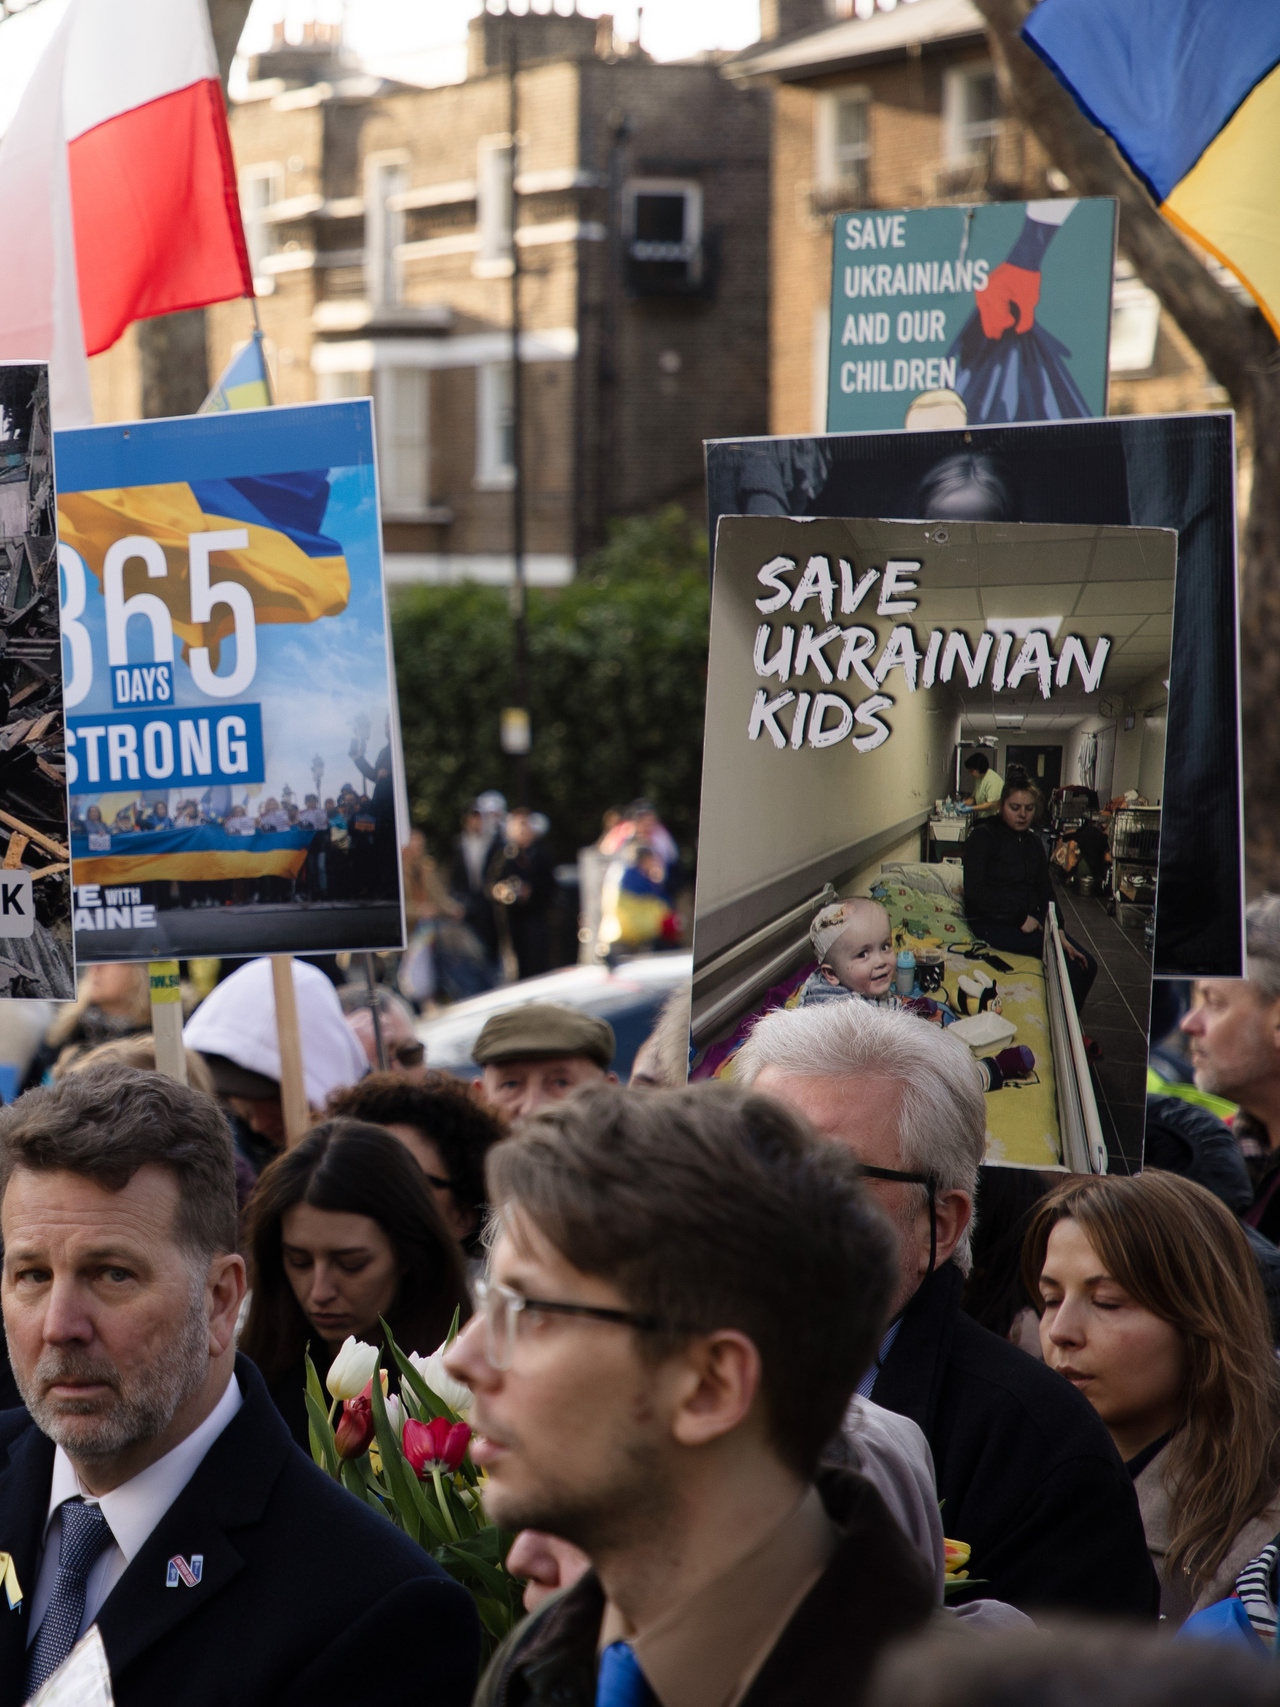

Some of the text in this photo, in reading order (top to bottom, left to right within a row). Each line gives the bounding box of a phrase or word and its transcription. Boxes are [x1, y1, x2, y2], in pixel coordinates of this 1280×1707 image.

[845, 215, 907, 250] SAVE
[844, 259, 990, 298] UKRAINIANS
[841, 309, 946, 346] AND OUR
[840, 357, 957, 394] CHILDREN
[755, 556, 921, 623] SAVE
[753, 624, 1111, 700] UKRAINIAN
[115, 666, 170, 704] DAYS
[748, 689, 894, 753] KIDS
[73, 884, 141, 907] E WITH
[74, 904, 157, 931] AINE
